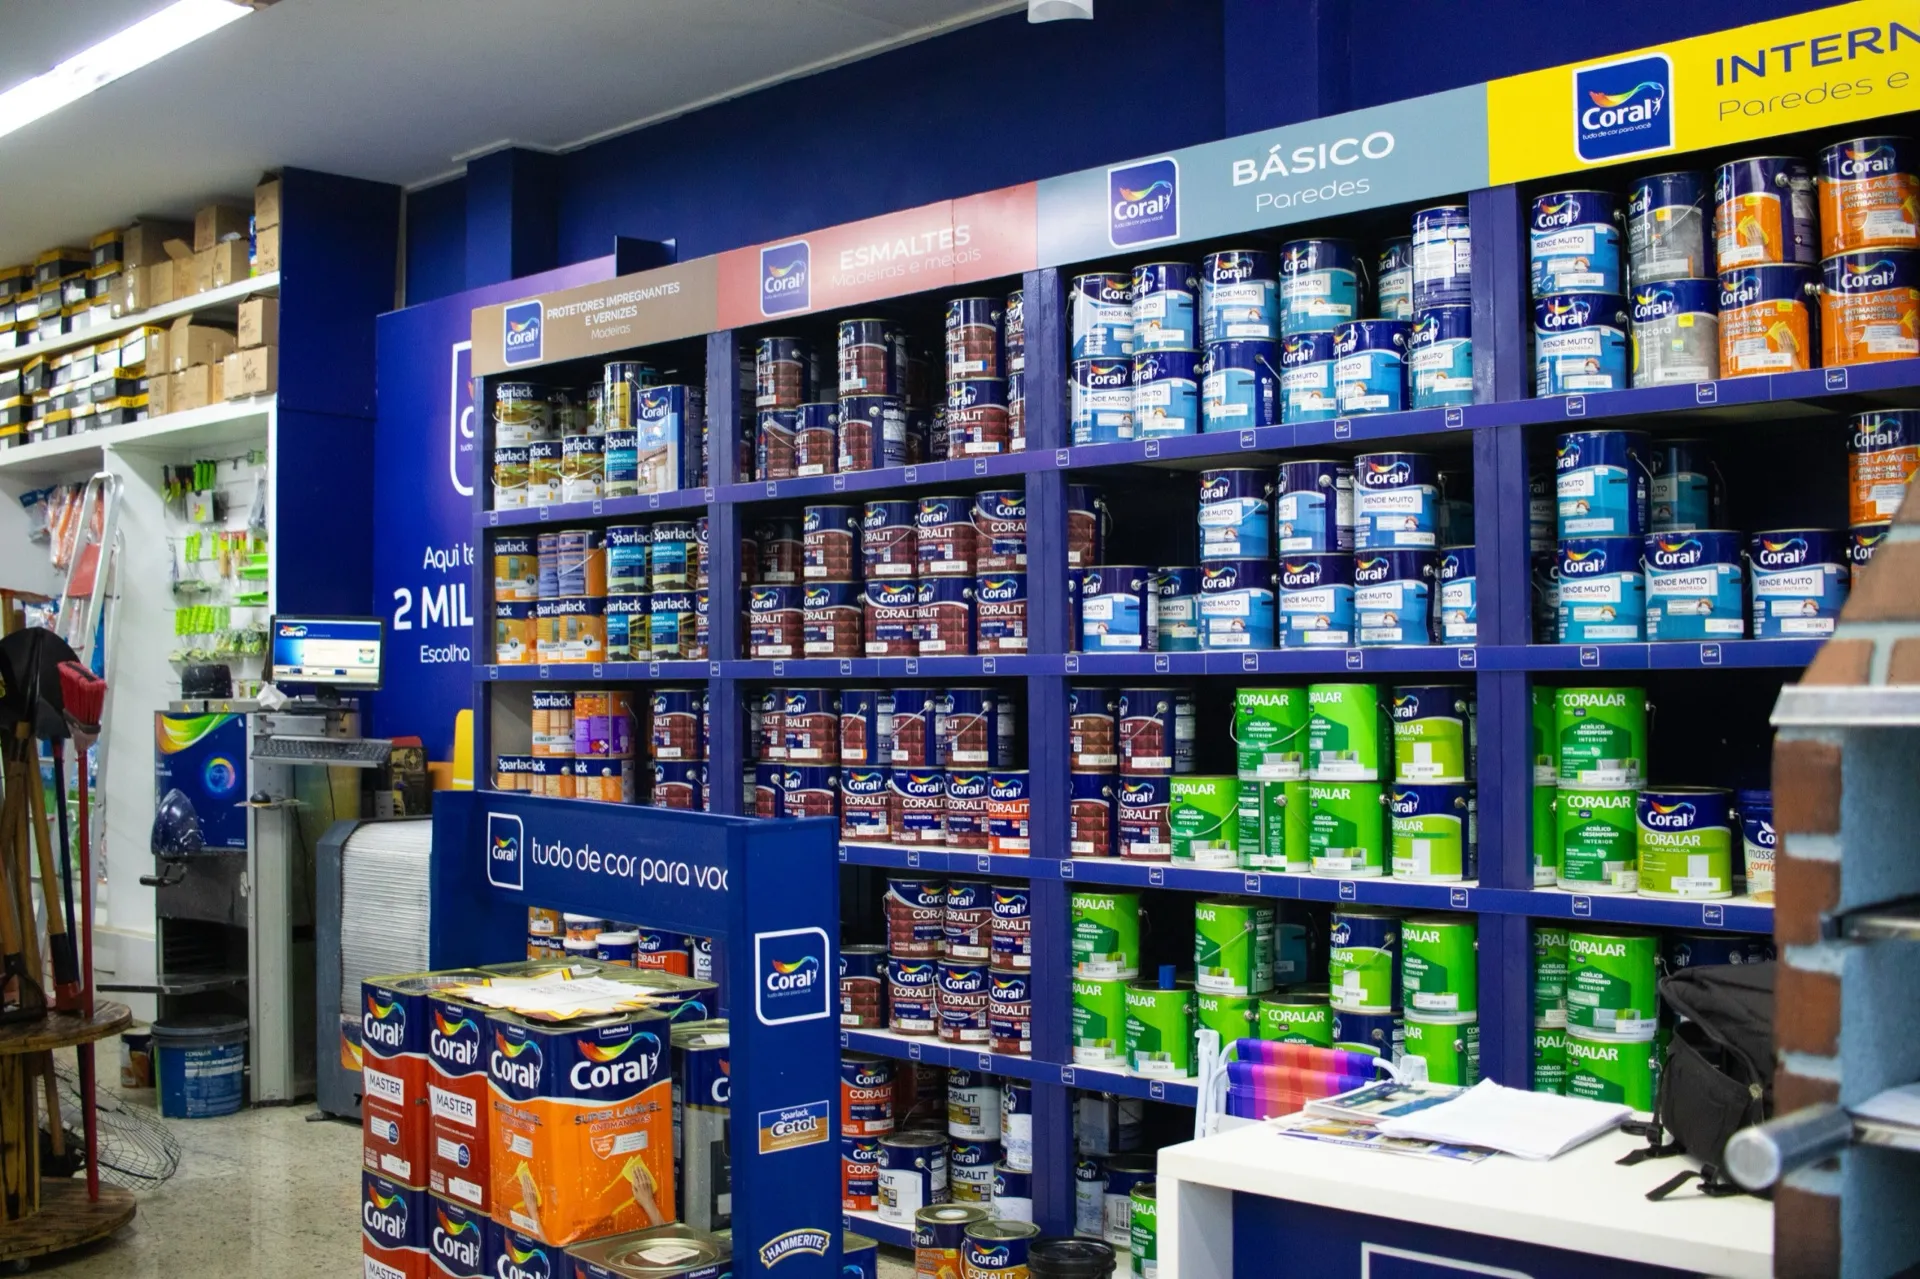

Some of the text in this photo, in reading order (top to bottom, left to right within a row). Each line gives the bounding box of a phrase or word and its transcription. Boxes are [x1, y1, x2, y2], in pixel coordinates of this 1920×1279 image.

[1718, 71, 1910, 122] Paredes e
[1582, 99, 1651, 130] Coral
[1619, 126, 1634, 134] para
[1635, 122, 1652, 130] você
[1232, 131, 1395, 186] BÁSICO
[1841, 156, 1888, 175] Coral
[1256, 177, 1371, 213] Paredes
[1830, 183, 1863, 197] SUPER
[1113, 194, 1164, 221] Coral
[1538, 210, 1572, 229] Coral
[839, 225, 971, 270] ESMALTES
[1536, 236, 1585, 249] RENDE MUITO
[831, 245, 982, 289] Madeiras e metais
[1284, 255, 1316, 272] Coral
[1214, 267, 1247, 281] Coral
[1841, 271, 1888, 289] Coral
[764, 274, 801, 294] Coral
[1385, 278, 1404, 286] MUITO
[1235, 289, 1257, 297] MUITO
[1720, 283, 1753, 305] Coral
[546, 281, 681, 320] PROTETORES IMPREGNANTES
[1830, 296, 1862, 309] SUPER
[1634, 301, 1667, 318] Coral
[585, 306, 638, 327] E VERNIZES
[1544, 312, 1582, 328] Coral
[591, 324, 631, 340] Madeiras
[1635, 325, 1672, 337] Decora
[507, 331, 535, 346] Coral
[1543, 337, 1594, 349] RENDE MUITO
[1283, 350, 1308, 364] Coral
[1087, 373, 1121, 385] Coral
[496, 388, 533, 399] Sparlack
[948, 393, 970, 407] Coral
[642, 406, 664, 419] Coral
[1854, 430, 1892, 448] Coral
[1872, 450, 1919, 464] LAVÁVEL
[1366, 473, 1404, 485] Coral
[1565, 479, 1584, 488] MUITO
[1364, 495, 1413, 504] RENDE MUITO
[920, 512, 944, 524] Coral
[1212, 509, 1233, 517] MUITO
[654, 527, 698, 540] Sparlack
[918, 528, 955, 539] CORALIT
[423, 543, 459, 573] Aqui
[1655, 549, 1695, 565] Coral
[1760, 549, 1799, 565] Coral
[1564, 559, 1599, 573] Coral
[1284, 572, 1314, 585] Coral
[1355, 568, 1382, 581] Coral
[1202, 575, 1230, 589] Coral
[1654, 577, 1707, 586] RENDE MUITO
[1759, 577, 1813, 587] RENDE MUITO
[983, 586, 1011, 599] Coral
[1369, 592, 1393, 600] MUITO
[1563, 585, 1610, 594] RENDE MUITO
[880, 590, 911, 603] Coral
[1218, 599, 1240, 607] MUITO
[1301, 595, 1325, 603] MUITO
[394, 583, 473, 631] 2 MIL
[751, 598, 773, 609] Coral
[979, 604, 1024, 615] CORALIT
[1162, 604, 1184, 612] MUITO
[280, 627, 304, 637] Coral
[420, 644, 470, 663] Escolha
[533, 695, 572, 708] Sparlack
[1238, 694, 1289, 705] CORALAR
[1563, 693, 1626, 707] CORALAR
[1580, 723, 1605, 731] ACRÍLICO
[848, 778, 878, 790] Coral
[907, 780, 942, 793] Coral
[951, 782, 982, 796] Coral
[1171, 783, 1216, 795] CORALAR
[991, 785, 1017, 798] Coral
[1121, 790, 1147, 803] Coral
[845, 795, 888, 806] CORALIT
[948, 801, 989, 811] CORALIT
[1567, 794, 1631, 809] CORALAR
[989, 802, 1030, 814] CORALIT
[1120, 809, 1161, 820] CORALIT
[1647, 812, 1687, 827] Coral
[1644, 833, 1700, 846] CORALAR
[492, 847, 515, 862] Coral
[532, 836, 573, 869] tudo
[576, 843, 601, 873] de
[604, 854, 635, 878] cor
[640, 856, 690, 886] para
[947, 893, 969, 906] Coral
[994, 901, 1021, 914] Coral
[992, 919, 1031, 931] CORALIT
[1569, 938, 1626, 957] CORALAR
[767, 970, 813, 991] Coral
[898, 971, 927, 983] Coral
[1580, 971, 1604, 979] ACRÍLICO
[945, 977, 976, 990] Coral
[1578, 984, 1605, 992] INTERIOR
[992, 986, 1021, 999] Coral
[942, 994, 987, 1005] CORALIT
[990, 1005, 1031, 1016] CORALIT
[1268, 1009, 1325, 1022] CORALAR
[364, 1013, 399, 1047] Coral
[431, 1028, 471, 1065] Coral
[491, 1050, 535, 1089] Coral
[570, 1053, 649, 1091] Coral
[369, 1073, 401, 1095] MASTER
[856, 1074, 885, 1085] Coral
[849, 1086, 893, 1100] CORALIT
[1573, 1087, 1599, 1096] INTERIOR
[436, 1093, 473, 1116] MASTER
[574, 1111, 614, 1126] SUPER
[780, 1108, 809, 1120] Sparlack
[771, 1115, 817, 1137] Cetol
[951, 1152, 976, 1164] Coral
[364, 1201, 400, 1239] Coral
[433, 1227, 474, 1267] Coral
[766, 1233, 825, 1261] HAMMERITE
[971, 1252, 1003, 1266] Coral
[368, 1261, 403, 1279] MASTER
